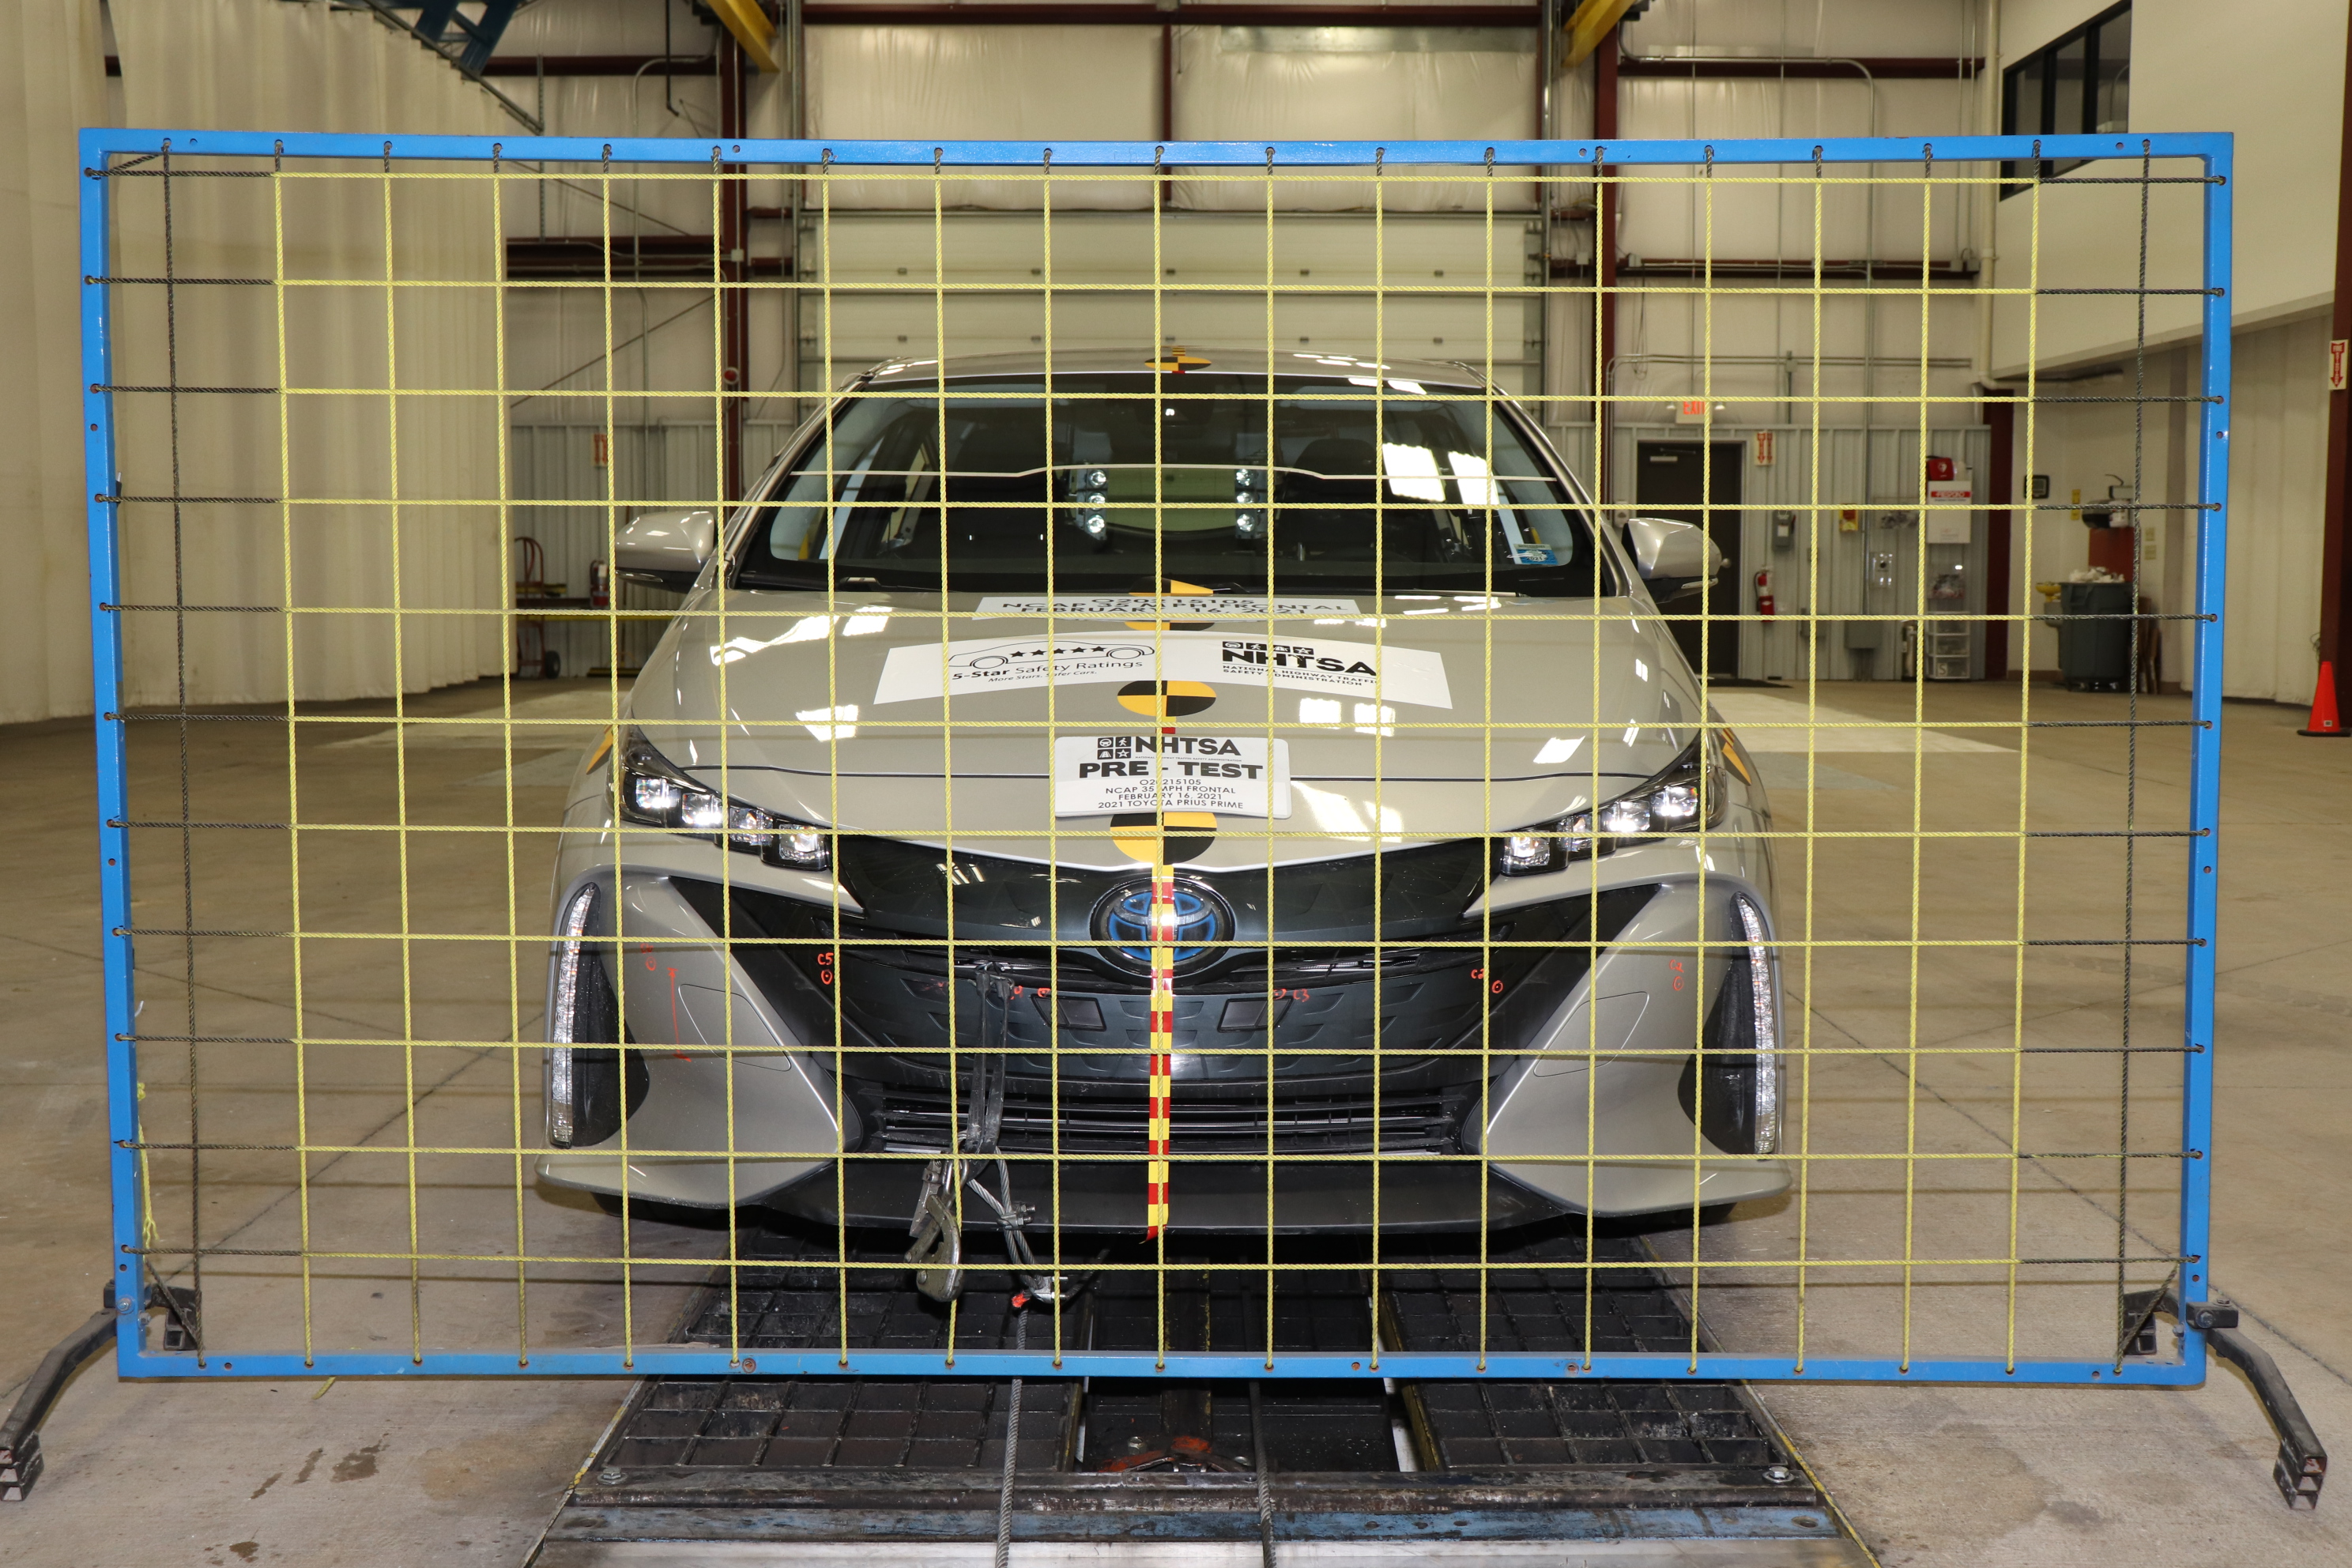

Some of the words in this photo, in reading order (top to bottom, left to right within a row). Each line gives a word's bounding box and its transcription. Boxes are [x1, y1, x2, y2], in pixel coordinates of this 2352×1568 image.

[1223, 649, 1377, 677] NHTSA
[952, 669, 1010, 680] 5-Star
[1016, 665, 1071, 674] Safety
[1266, 673, 1362, 685] DMINISTRATION
[1136, 737, 1242, 756] NHTSA
[1080, 761, 1149, 778] PRE
[1178, 761, 1263, 779] TEST
[817, 952, 834, 965] C5
[1293, 988, 1310, 1002] C3
